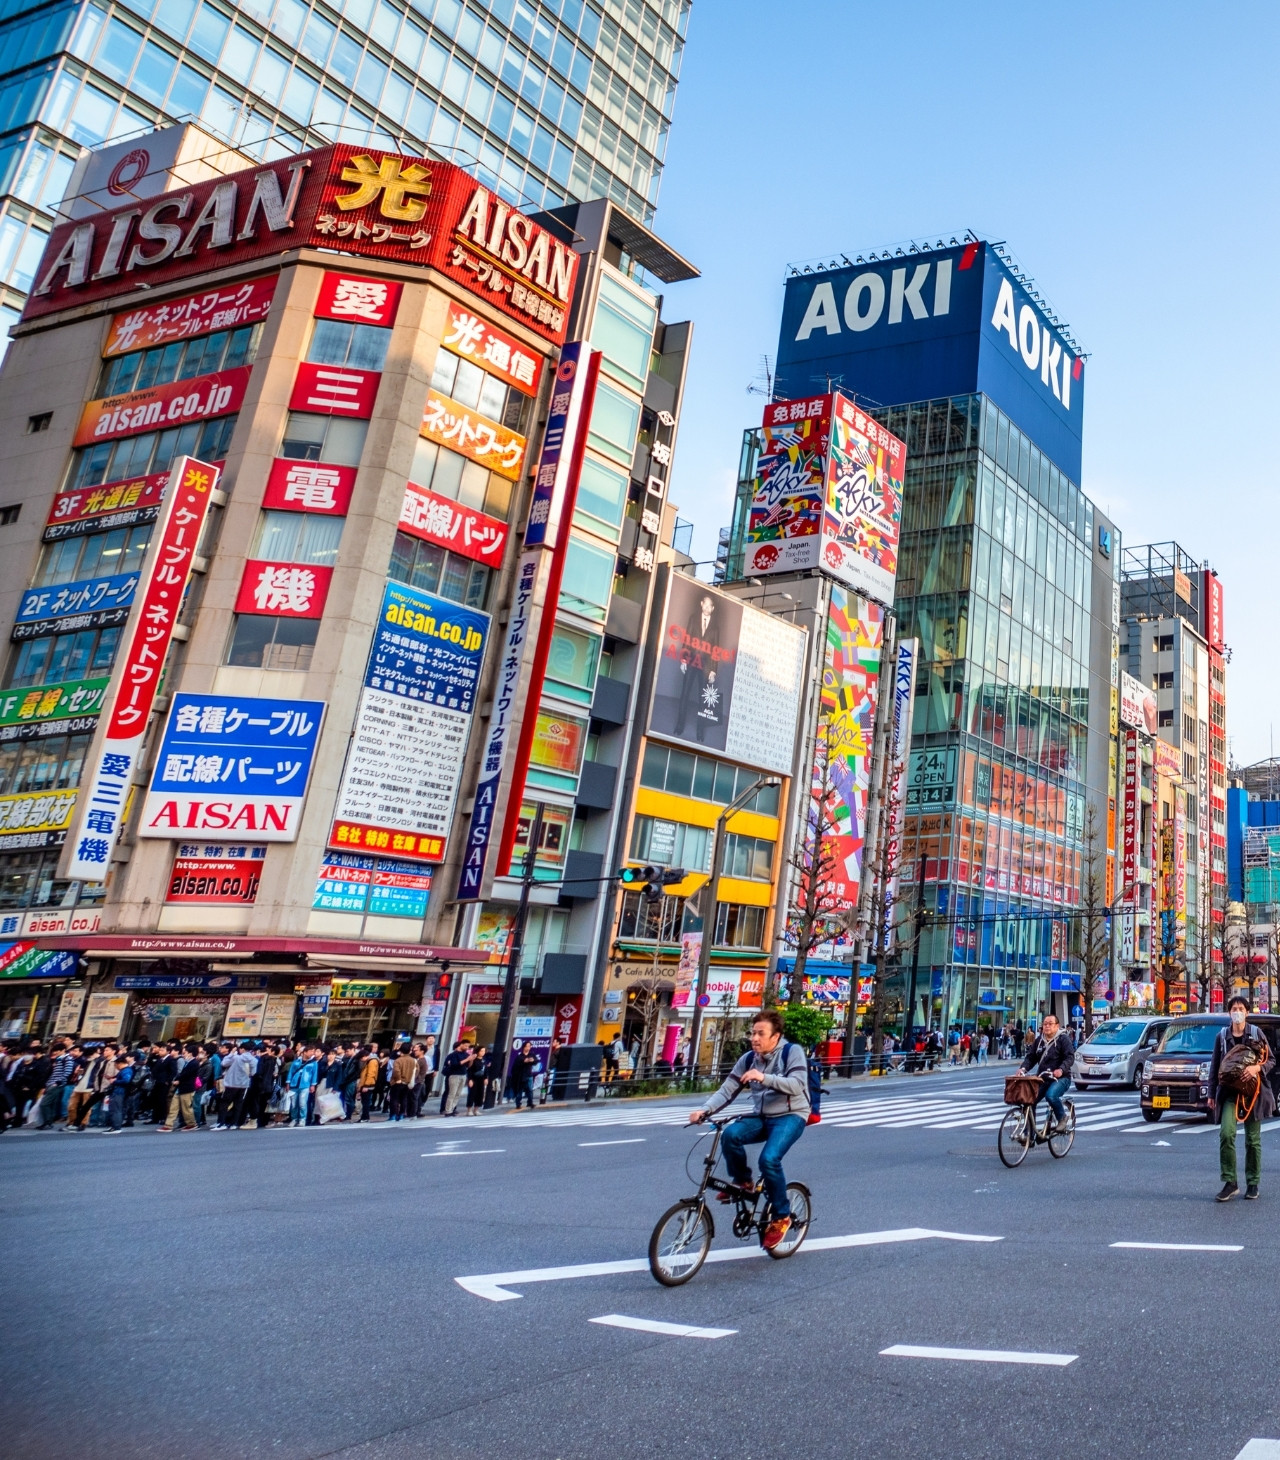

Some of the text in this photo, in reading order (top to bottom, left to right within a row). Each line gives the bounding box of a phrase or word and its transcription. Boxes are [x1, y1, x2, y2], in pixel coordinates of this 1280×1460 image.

[335, 154, 432, 221] 光
[33, 159, 312, 296] AISAN
[315, 214, 431, 249] ネットワーク
[457, 187, 575, 302] AISAN
[330, 279, 388, 320] 愛
[795, 258, 953, 342] AOKI
[108, 311, 148, 353] 光
[991, 276, 1073, 411] AOKI
[444, 313, 537, 386] 光通信
[94, 383, 233, 436] aisan.co.jp
[773, 399, 824, 423] 免税店
[423, 399, 523, 467] ネットワーク
[842, 402, 901, 459] 愛客免税店
[530, 392, 570, 526] 愛三電機
[285, 464, 341, 509] 電
[759, 472, 808, 498] AKKY
[783, 486, 819, 496] INTERNATIONAL
[838, 481, 882, 514] AKKY
[54, 495, 81, 517] 3F
[399, 487, 504, 555] 配線パーツ
[859, 508, 892, 532] INTERNATIONAL
[785, 550, 811, 558] Tax-free
[788, 542, 811, 550] Japan.
[793, 556, 810, 565] Shop
[22, 593, 51, 616] 2F
[254, 566, 316, 612] 機
[390, 590, 433, 611] http://www.
[386, 603, 482, 651] aisan.co.jp
[1212, 583, 1220, 643] カラオケ
[665, 644, 703, 670] AGA
[668, 624, 737, 663] Change!
[897, 645, 912, 701] AKKY
[175, 704, 314, 737] 各種ケーブル
[161, 753, 302, 785] 配線パーツ
[914, 772, 945, 784] OPEN
[78, 752, 131, 864] 愛三電機
[148, 800, 292, 831] AISAN
[337, 826, 361, 843] 各社
[365, 830, 389, 848] 特約
[393, 834, 416, 851] 在庫
[463, 786, 493, 887] AISAN
[176, 862, 236, 870] http://www.
[171, 871, 260, 900] aisan.co.jp
[131, 939, 236, 950] http://www.aisan.co.jp
[359, 945, 433, 956] http://www.aisan.co.jp
[995, 914, 1037, 956] AOKI
[174, 977, 204, 987] 1949
[742, 980, 760, 992] au
